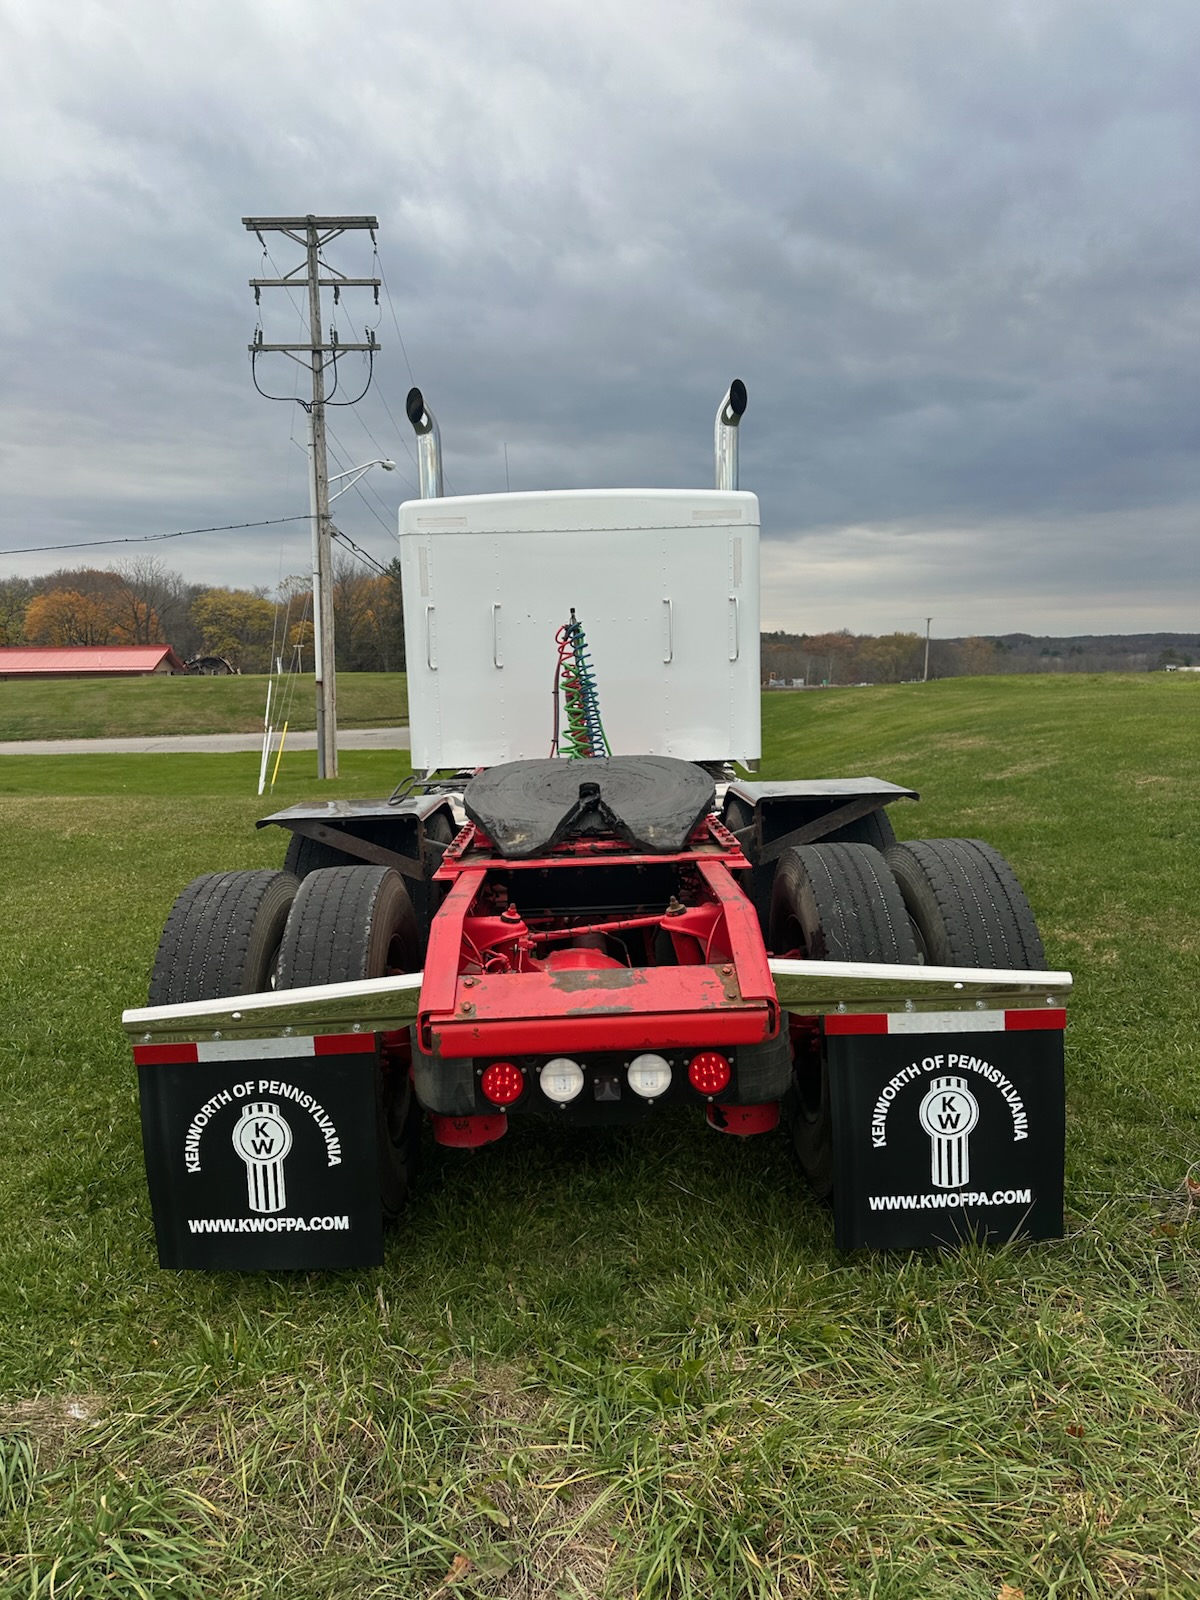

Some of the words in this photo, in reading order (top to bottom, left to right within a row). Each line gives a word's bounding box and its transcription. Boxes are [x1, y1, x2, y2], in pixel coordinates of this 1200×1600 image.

[184, 1089, 233, 1173] KENWORTH
[232, 1080, 255, 1098] OF
[258, 1079, 342, 1168] PENNSYLVANIA
[871, 1062, 922, 1148] KENWORTH
[921, 1054, 945, 1072] OF
[947, 1053, 1029, 1142] PENNSYLVANIA
[187, 1215, 350, 1234] WWW.KWOFPA.COM
[868, 1188, 1032, 1211] WWW.KWOFPA.COM
